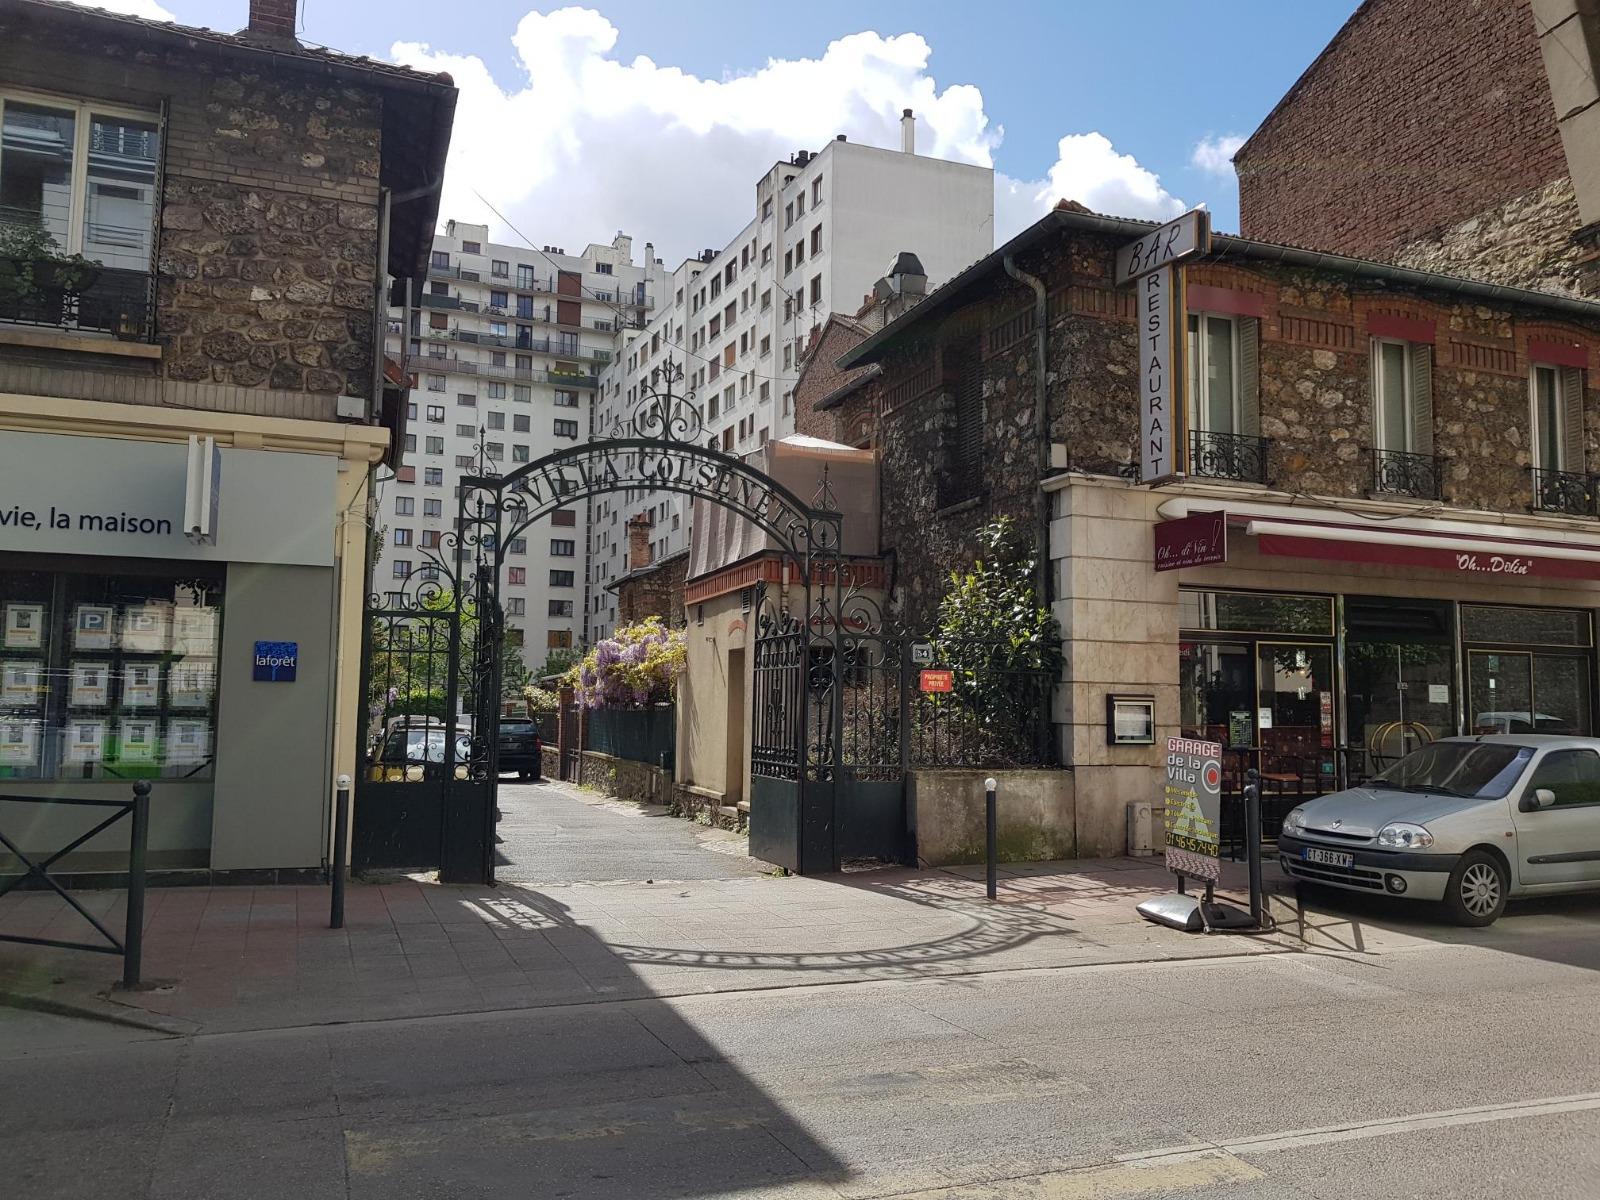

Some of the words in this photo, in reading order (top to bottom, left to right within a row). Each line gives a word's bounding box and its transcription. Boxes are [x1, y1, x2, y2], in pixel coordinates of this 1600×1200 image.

[1128, 224, 1181, 277] BAR
[1148, 274, 1164, 476] RESTAURANT
[521, 452, 622, 507] VILLA
[639, 453, 794, 530] COLSENET
[0, 506, 42, 531] vie,
[50, 507, 70, 529] la
[79, 512, 172, 535] maison
[256, 655, 296, 667] laforêt
[1168, 738, 1220, 758] GARAGE
[1168, 753, 1184, 767] de
[1188, 756, 1201, 770] la
[1168, 766, 1196, 784] Villa
[1166, 832, 1174, 845] 01
[1175, 835, 1186, 849] 46
[1186, 837, 1196, 851] 45
[1197, 840, 1207, 854] 74
[1207, 843, 1218, 857] 40
